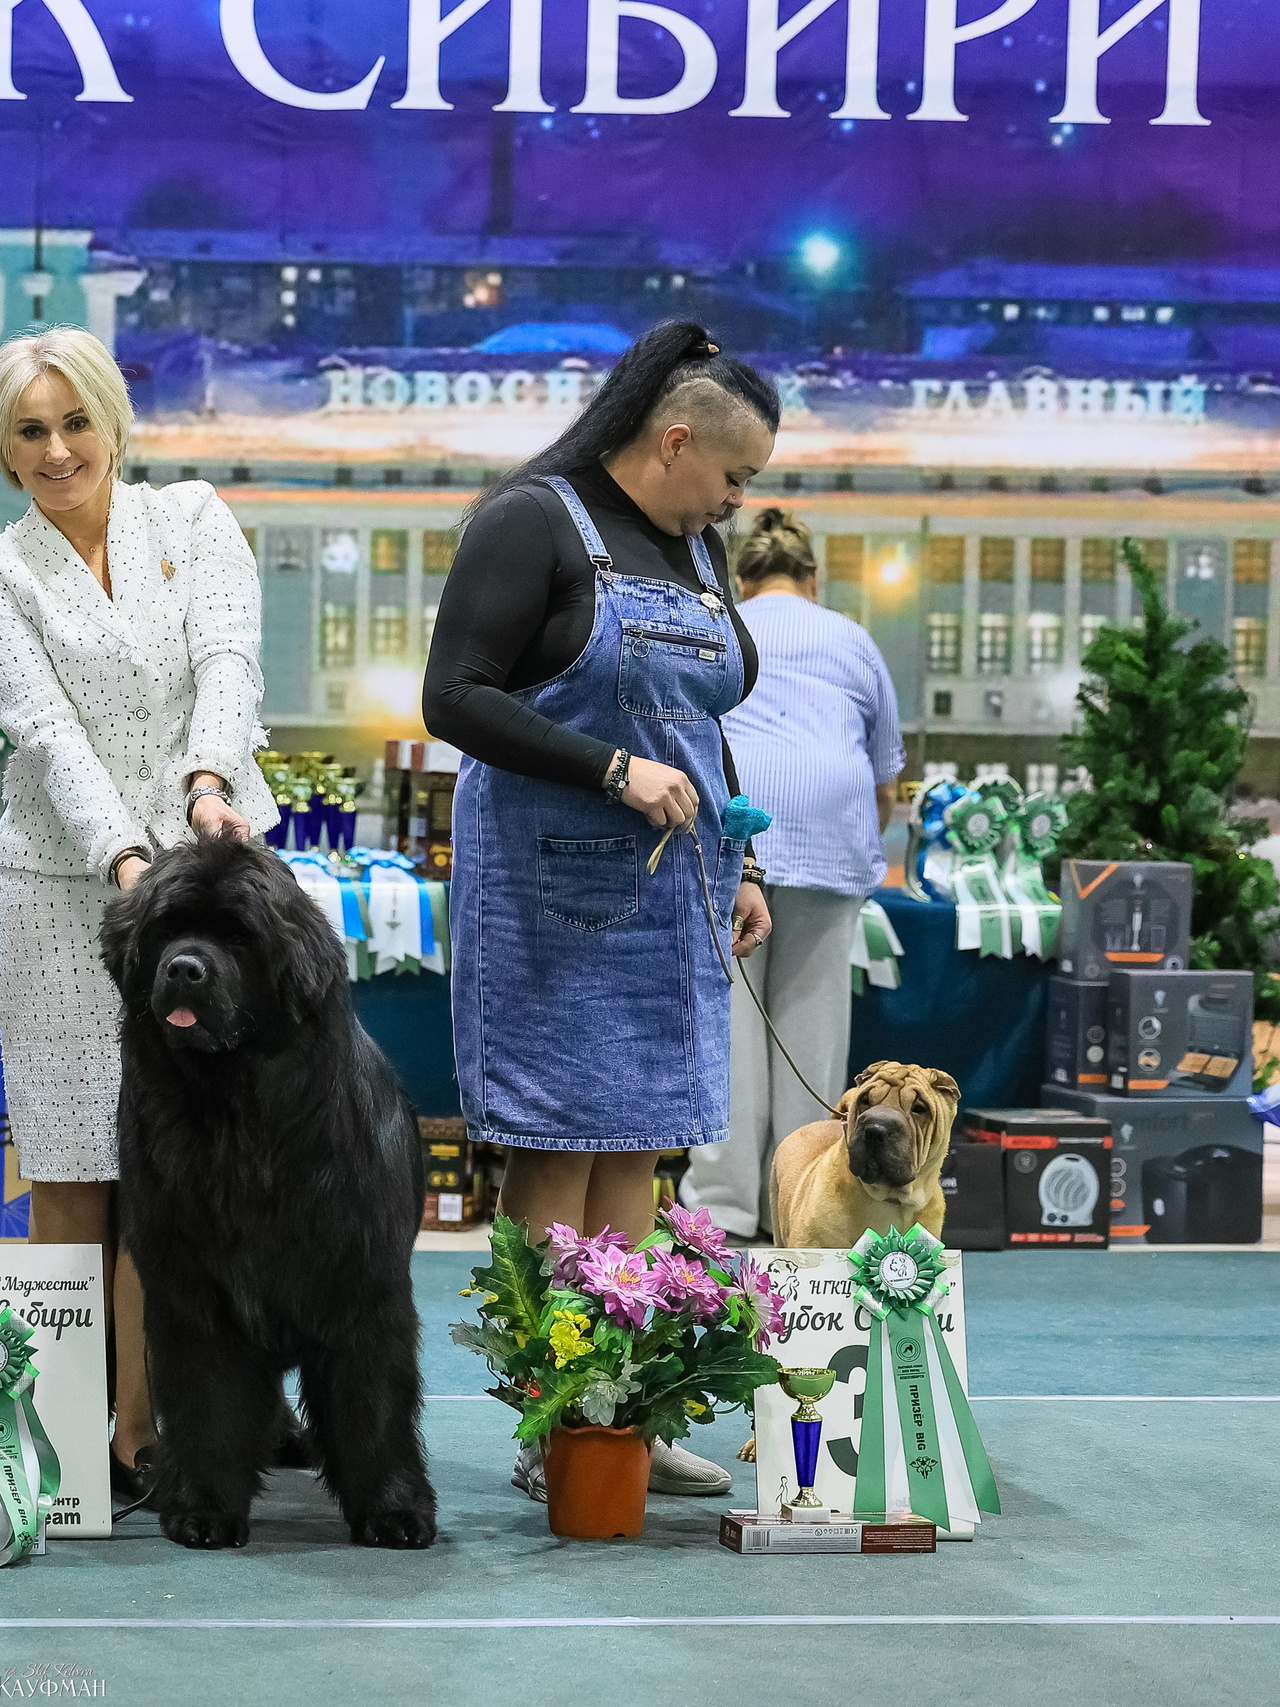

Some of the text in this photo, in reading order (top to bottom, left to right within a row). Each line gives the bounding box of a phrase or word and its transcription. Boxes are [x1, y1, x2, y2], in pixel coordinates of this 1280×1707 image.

[220, 0, 1212, 126] СИБИРИ
[910, 373, 1207, 423] ГЛАВНЫЙ
[809, 1279, 852, 1298] НГКЦ
[777, 1305, 844, 1344] убок
[908, 1384, 925, 1428] ПРИЗЁР
[915, 1432, 927, 1451] BIG
[17, 1508, 29, 1526] BIG
